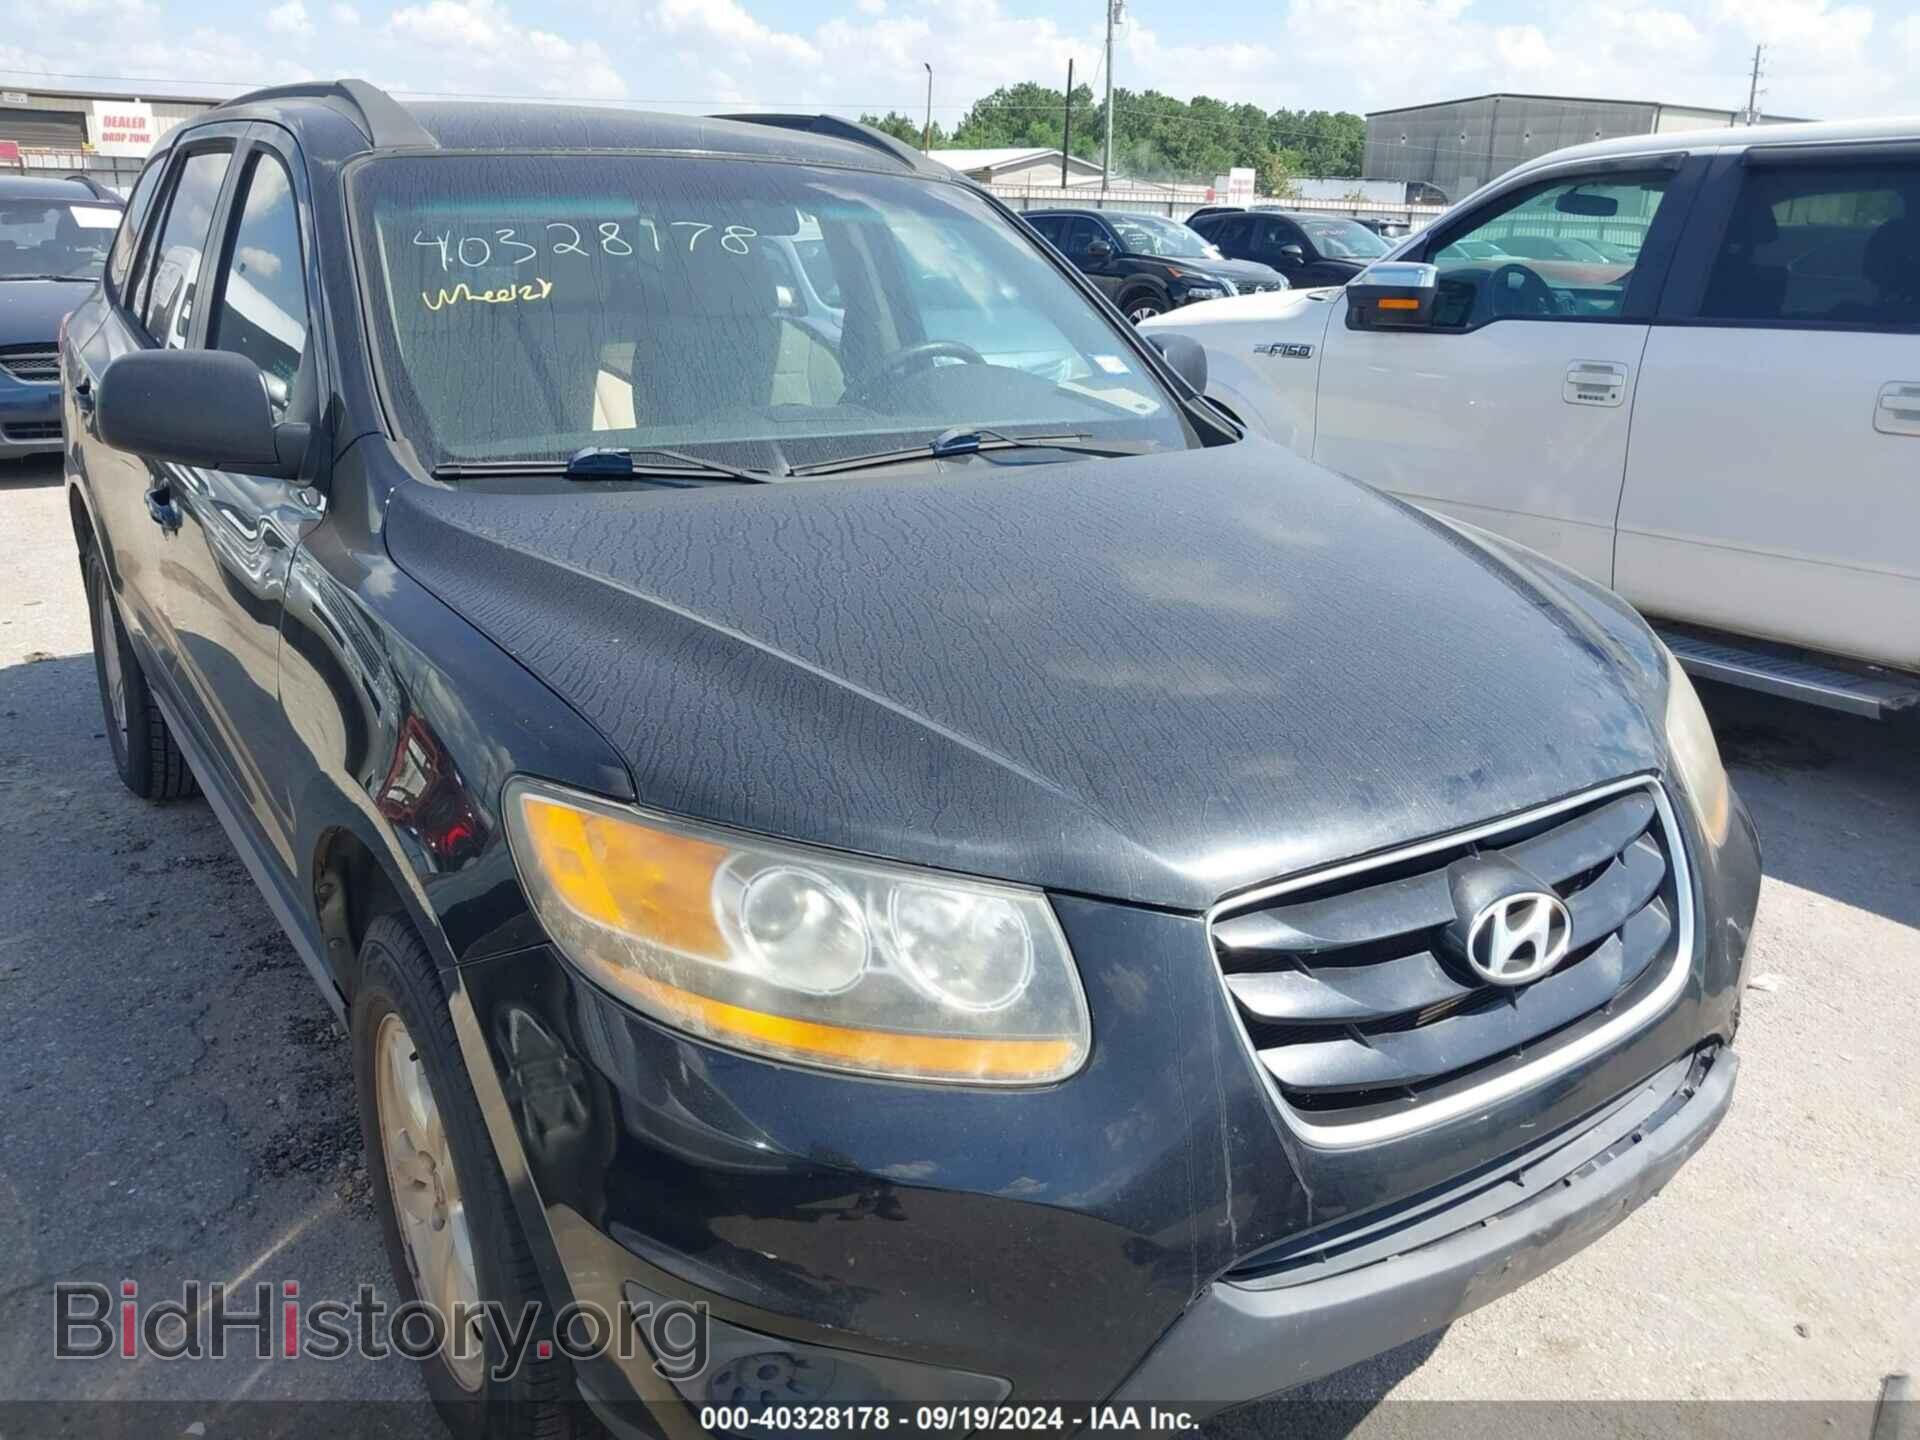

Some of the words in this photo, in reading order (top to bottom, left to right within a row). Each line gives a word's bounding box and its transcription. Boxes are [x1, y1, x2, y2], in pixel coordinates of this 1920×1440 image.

[103, 115, 145, 129] DEALER
[102, 132, 127, 142] DROP
[128, 133, 151, 144] ZONE
[413, 222, 758, 271] 40328178
